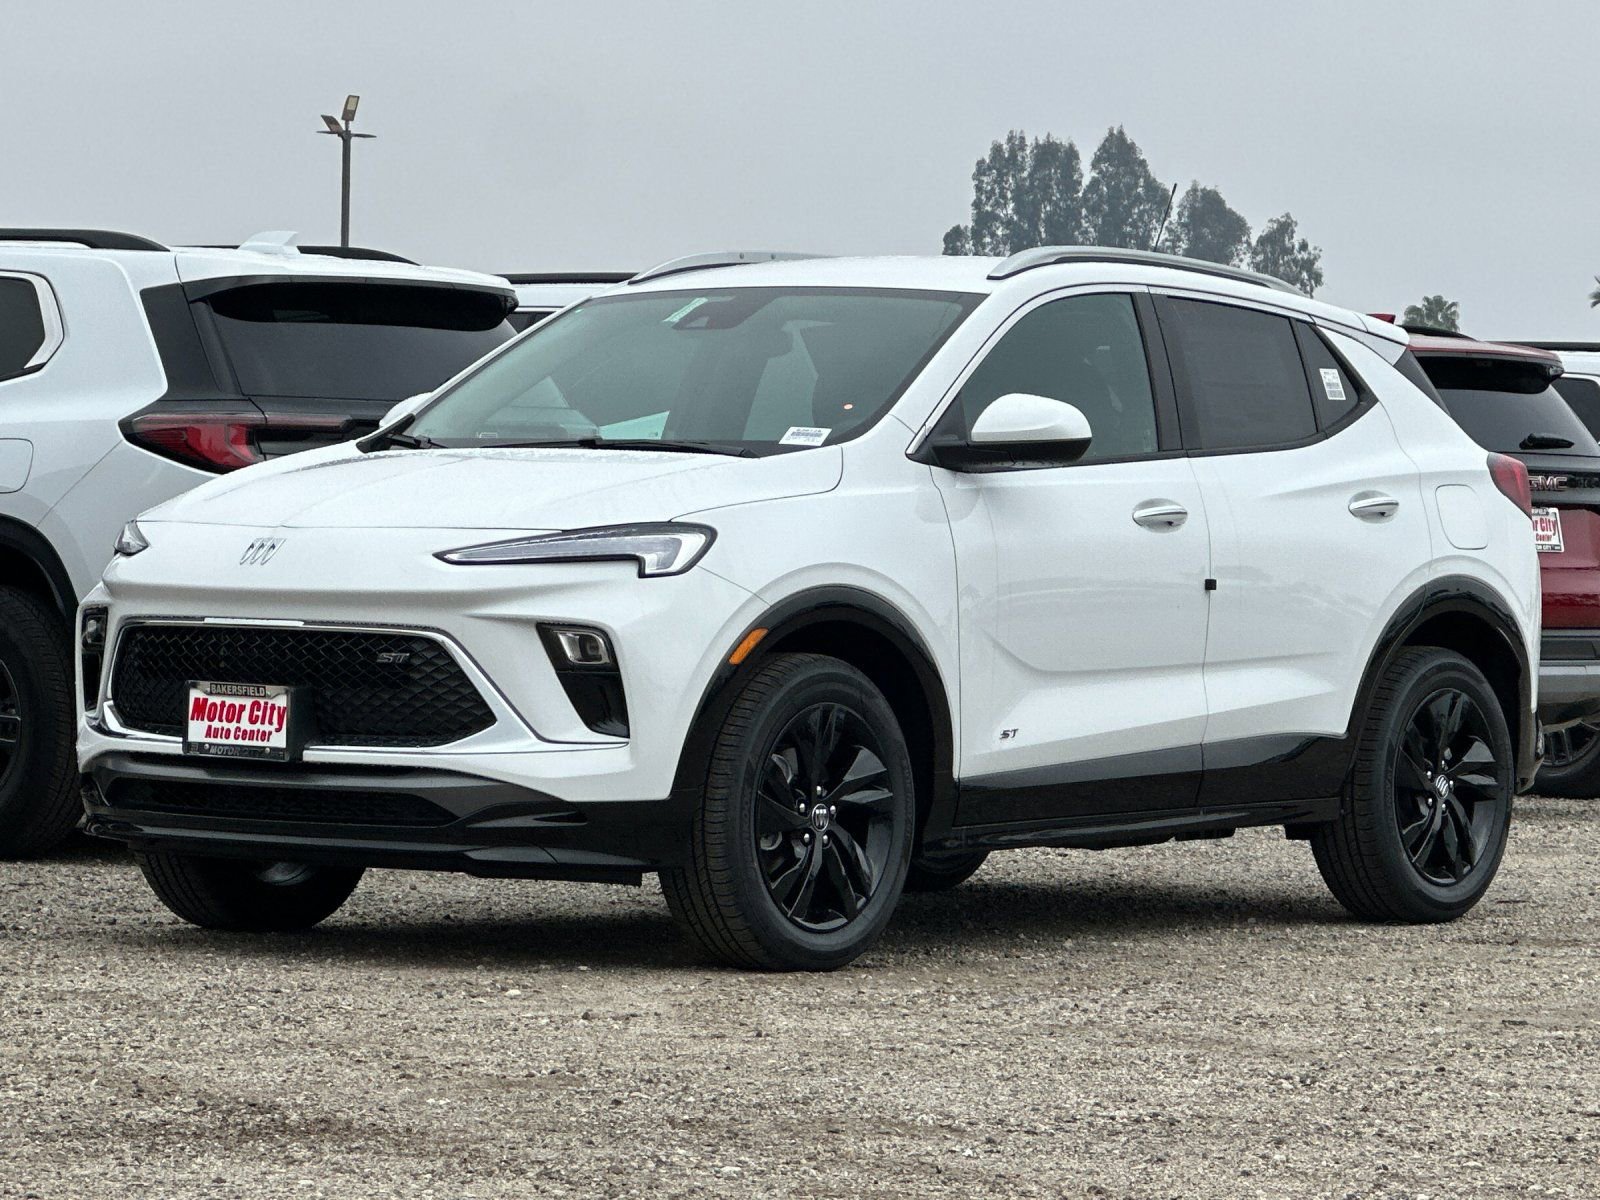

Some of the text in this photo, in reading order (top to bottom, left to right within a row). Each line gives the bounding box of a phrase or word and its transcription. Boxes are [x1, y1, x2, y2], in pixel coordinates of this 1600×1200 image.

[1539, 517, 1557, 536] City
[376, 653, 410, 663] ST
[211, 683, 265, 697] BAKERSFIELD
[190, 697, 287, 732] Motor City
[205, 725, 273, 742] Auto Center
[1000, 728, 1019, 740] ST
[209, 745, 240, 756] MOTOR
